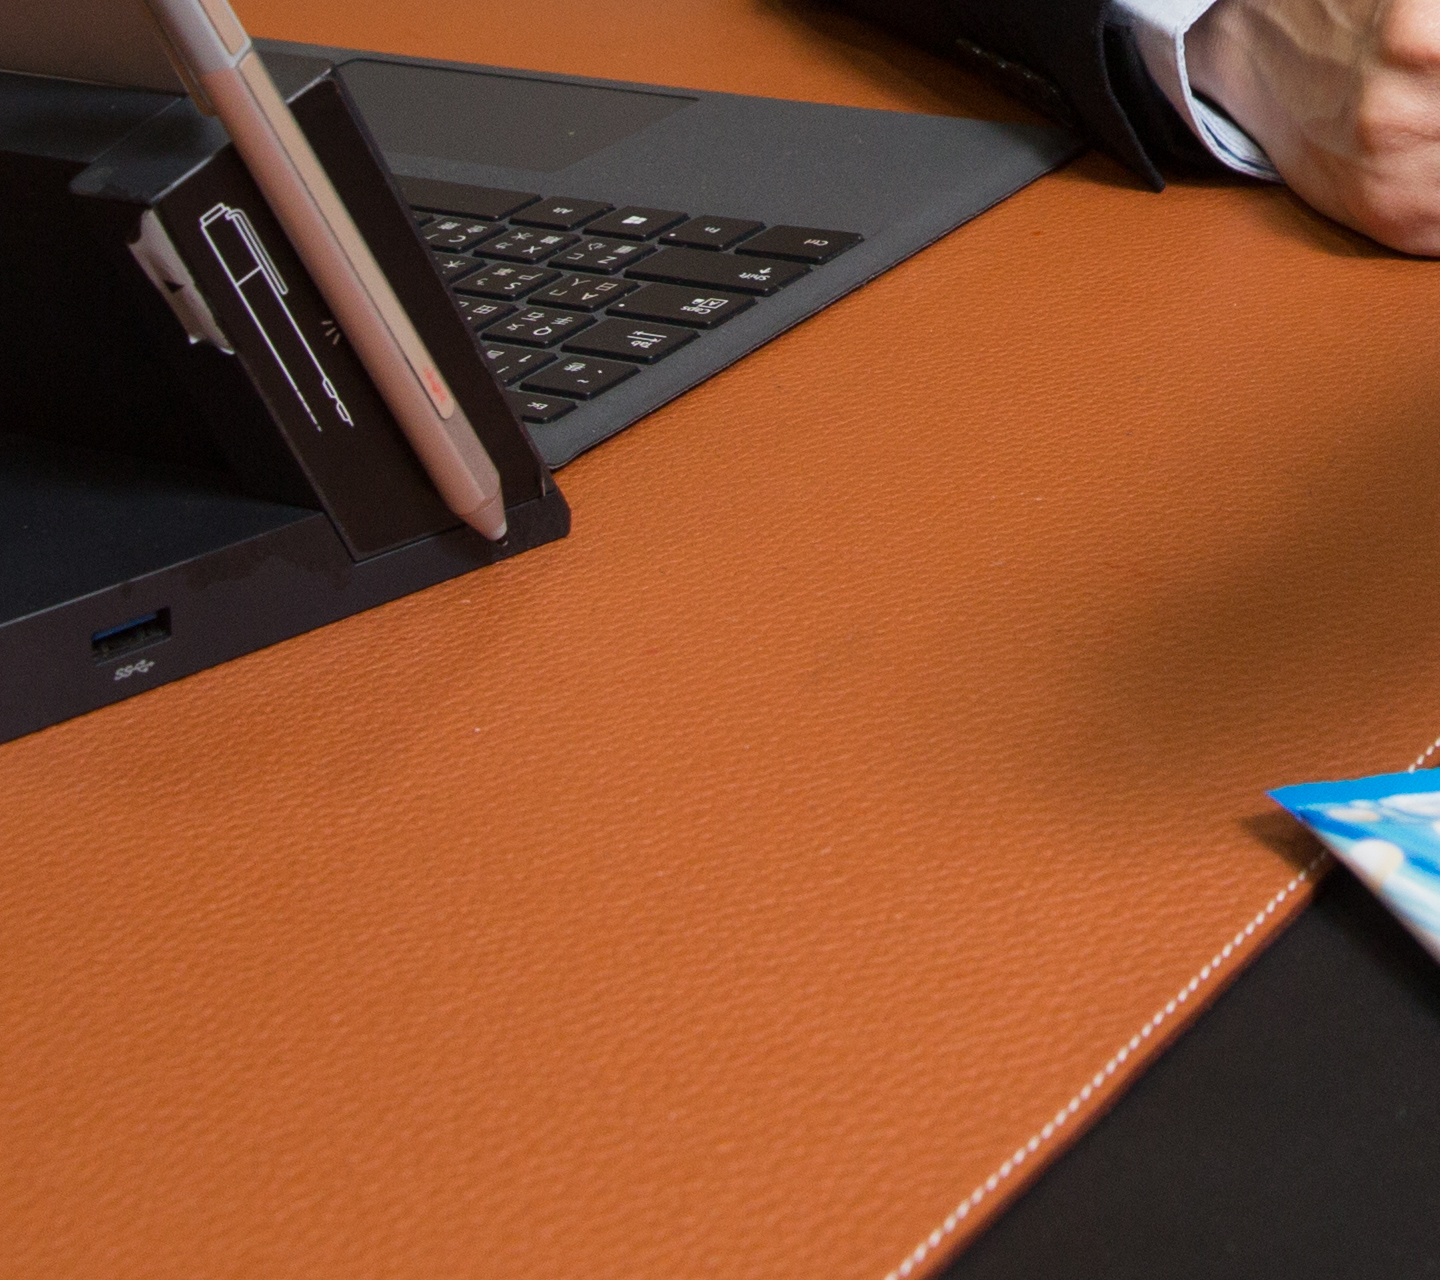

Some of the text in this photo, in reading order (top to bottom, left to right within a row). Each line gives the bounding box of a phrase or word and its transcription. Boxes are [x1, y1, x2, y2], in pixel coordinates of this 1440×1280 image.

[739, 272, 770, 281] Shift
[680, 306, 711, 315] Caps
[630, 340, 653, 349] Tab
[528, 402, 548, 410] Esc
